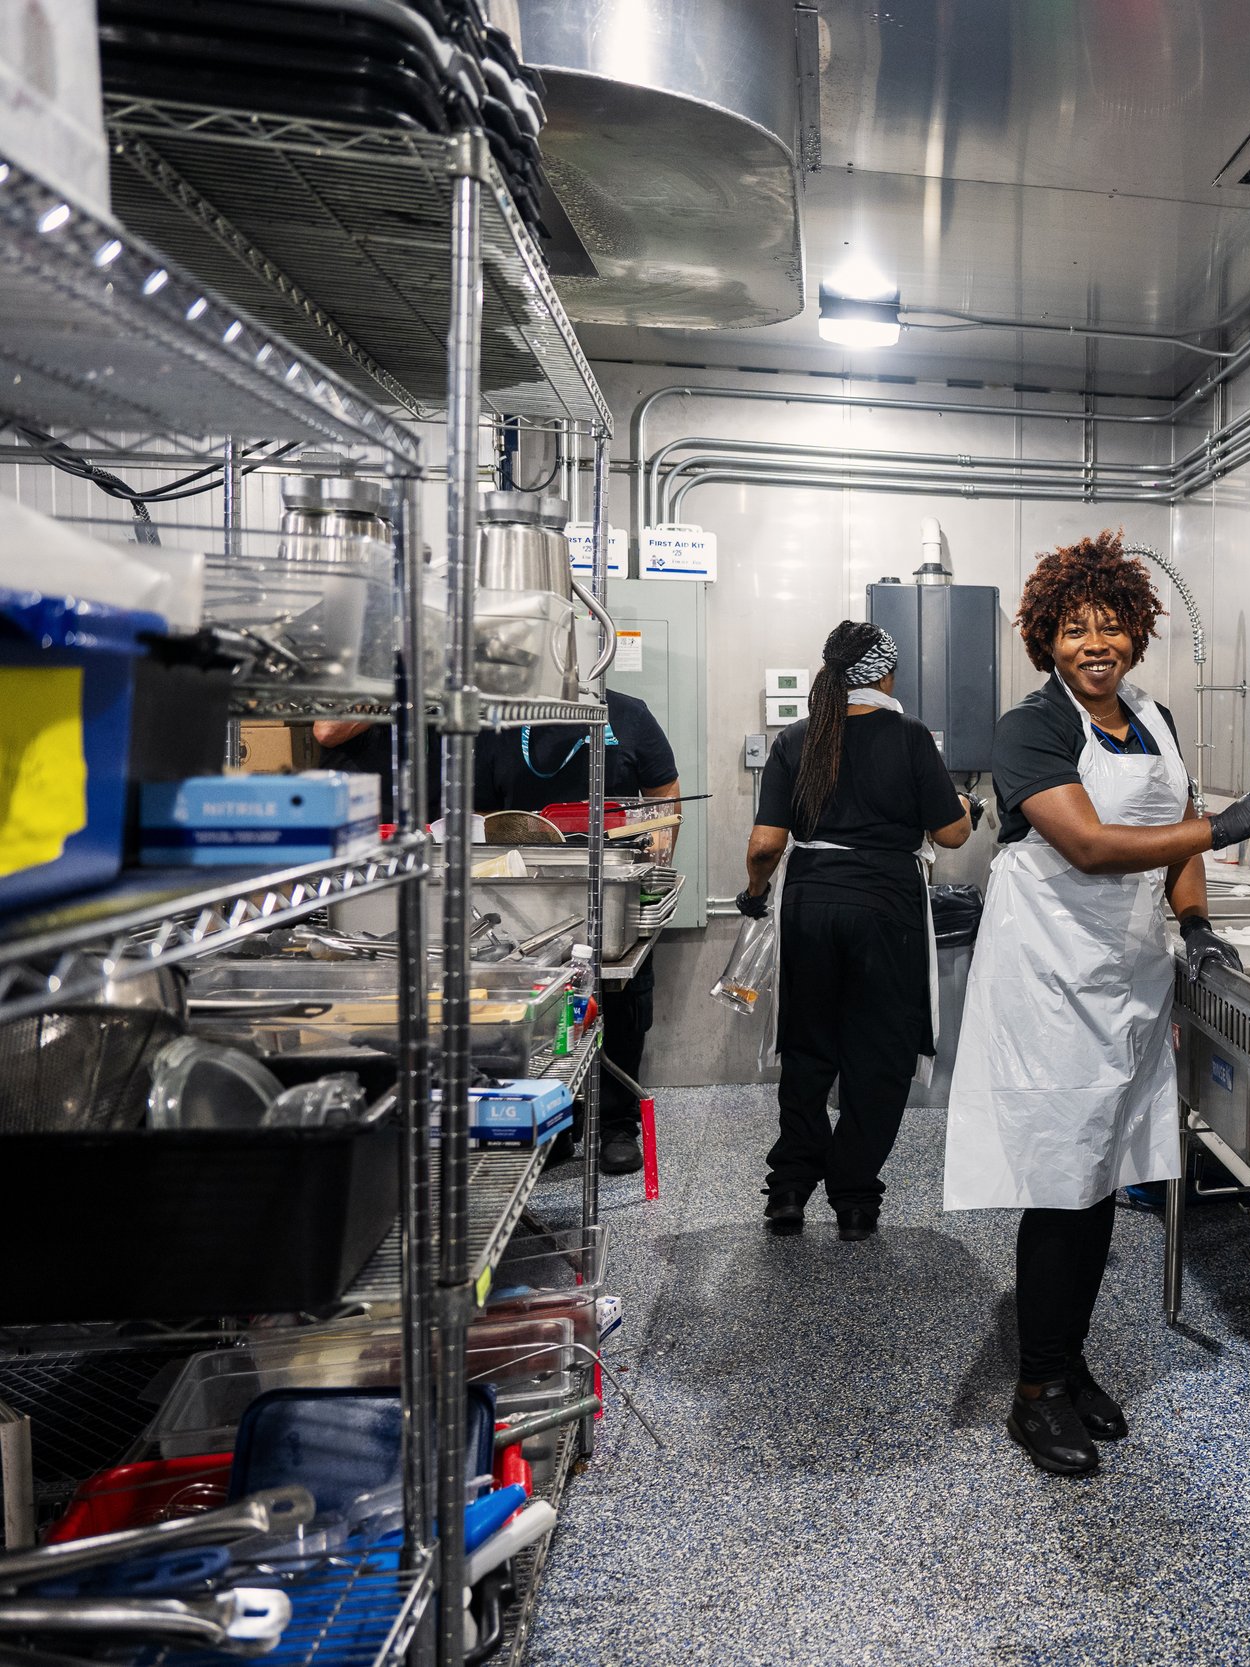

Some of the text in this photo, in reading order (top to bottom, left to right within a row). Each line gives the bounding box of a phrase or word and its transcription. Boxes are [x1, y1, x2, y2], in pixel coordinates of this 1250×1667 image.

[649, 539, 672, 548] FIRST
[691, 541, 705, 549] KIT
[491, 1105, 516, 1118] L/G
